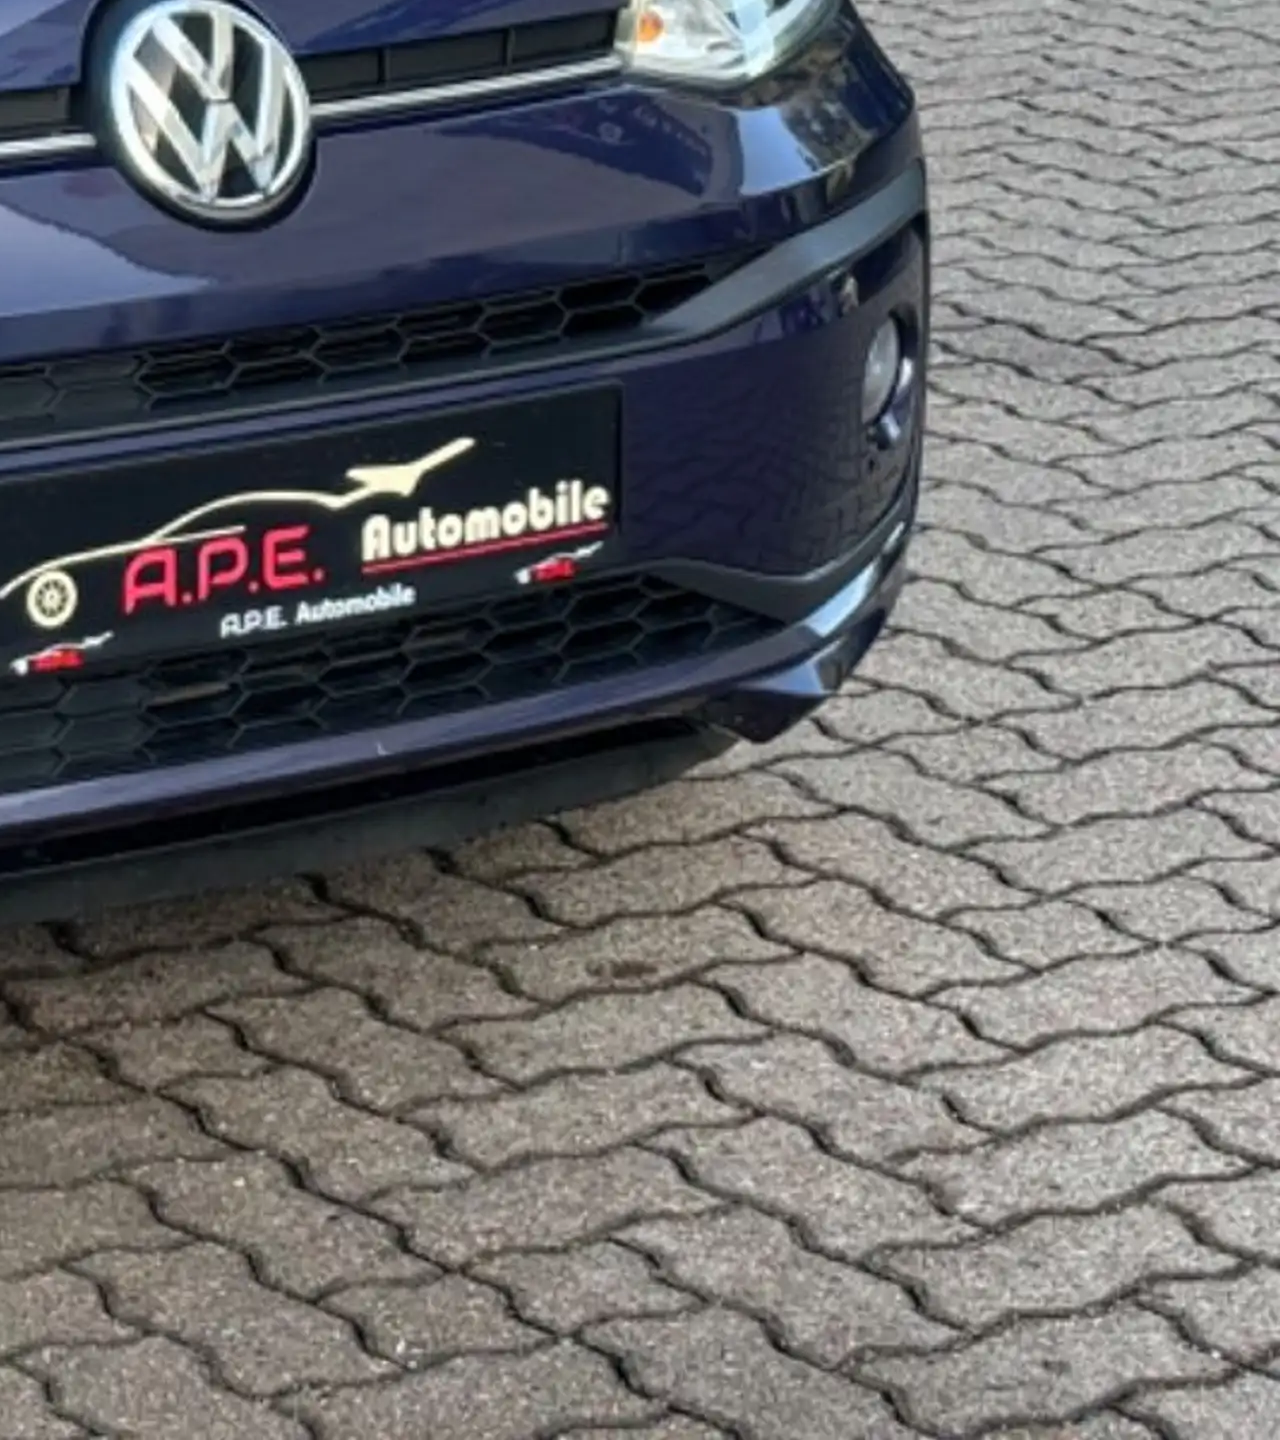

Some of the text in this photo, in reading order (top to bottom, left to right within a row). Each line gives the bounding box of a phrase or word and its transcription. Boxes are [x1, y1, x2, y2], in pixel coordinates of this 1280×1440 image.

[123, 478, 611, 615] A.P.E. Automobile
[295, 582, 417, 625] Automobile
